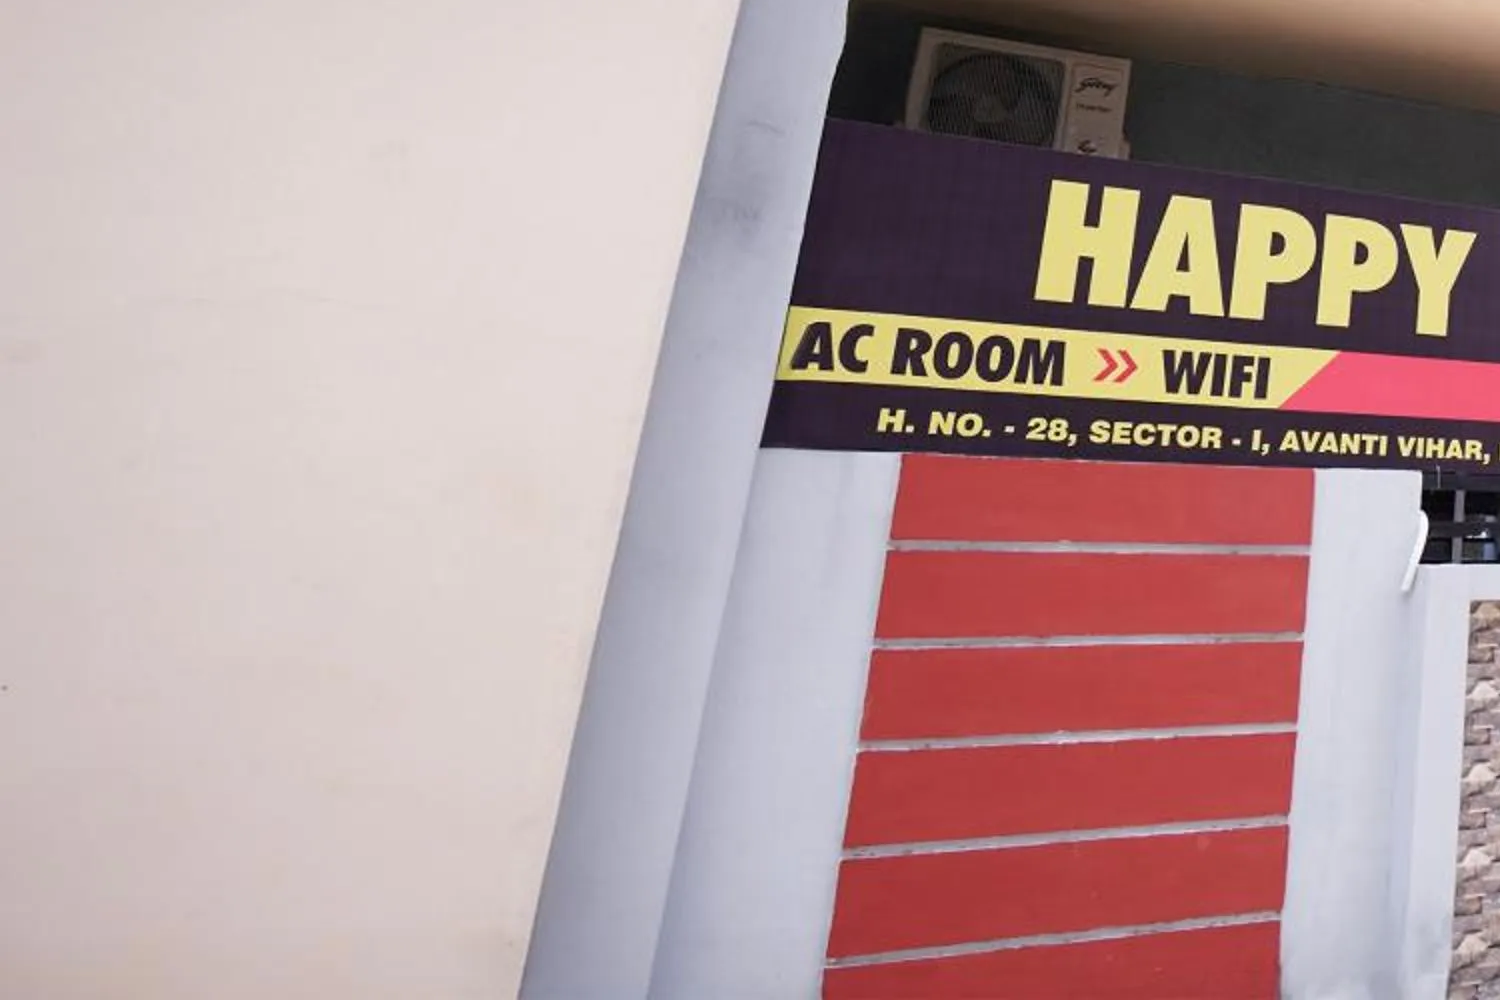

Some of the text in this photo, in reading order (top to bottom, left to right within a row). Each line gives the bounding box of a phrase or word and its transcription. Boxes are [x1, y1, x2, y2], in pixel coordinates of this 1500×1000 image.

[1034, 179, 1477, 337] HAPPY
[790, 321, 1271, 400] AC ROOM WIFI
[877, 407, 915, 434] H.
[928, 411, 992, 438] NO.
[1025, 417, 1077, 447] 28,
[1089, 419, 1223, 449] SECTOR
[1279, 429, 1388, 457] AVANTI
[1397, 435, 1491, 465] VIHAR,
